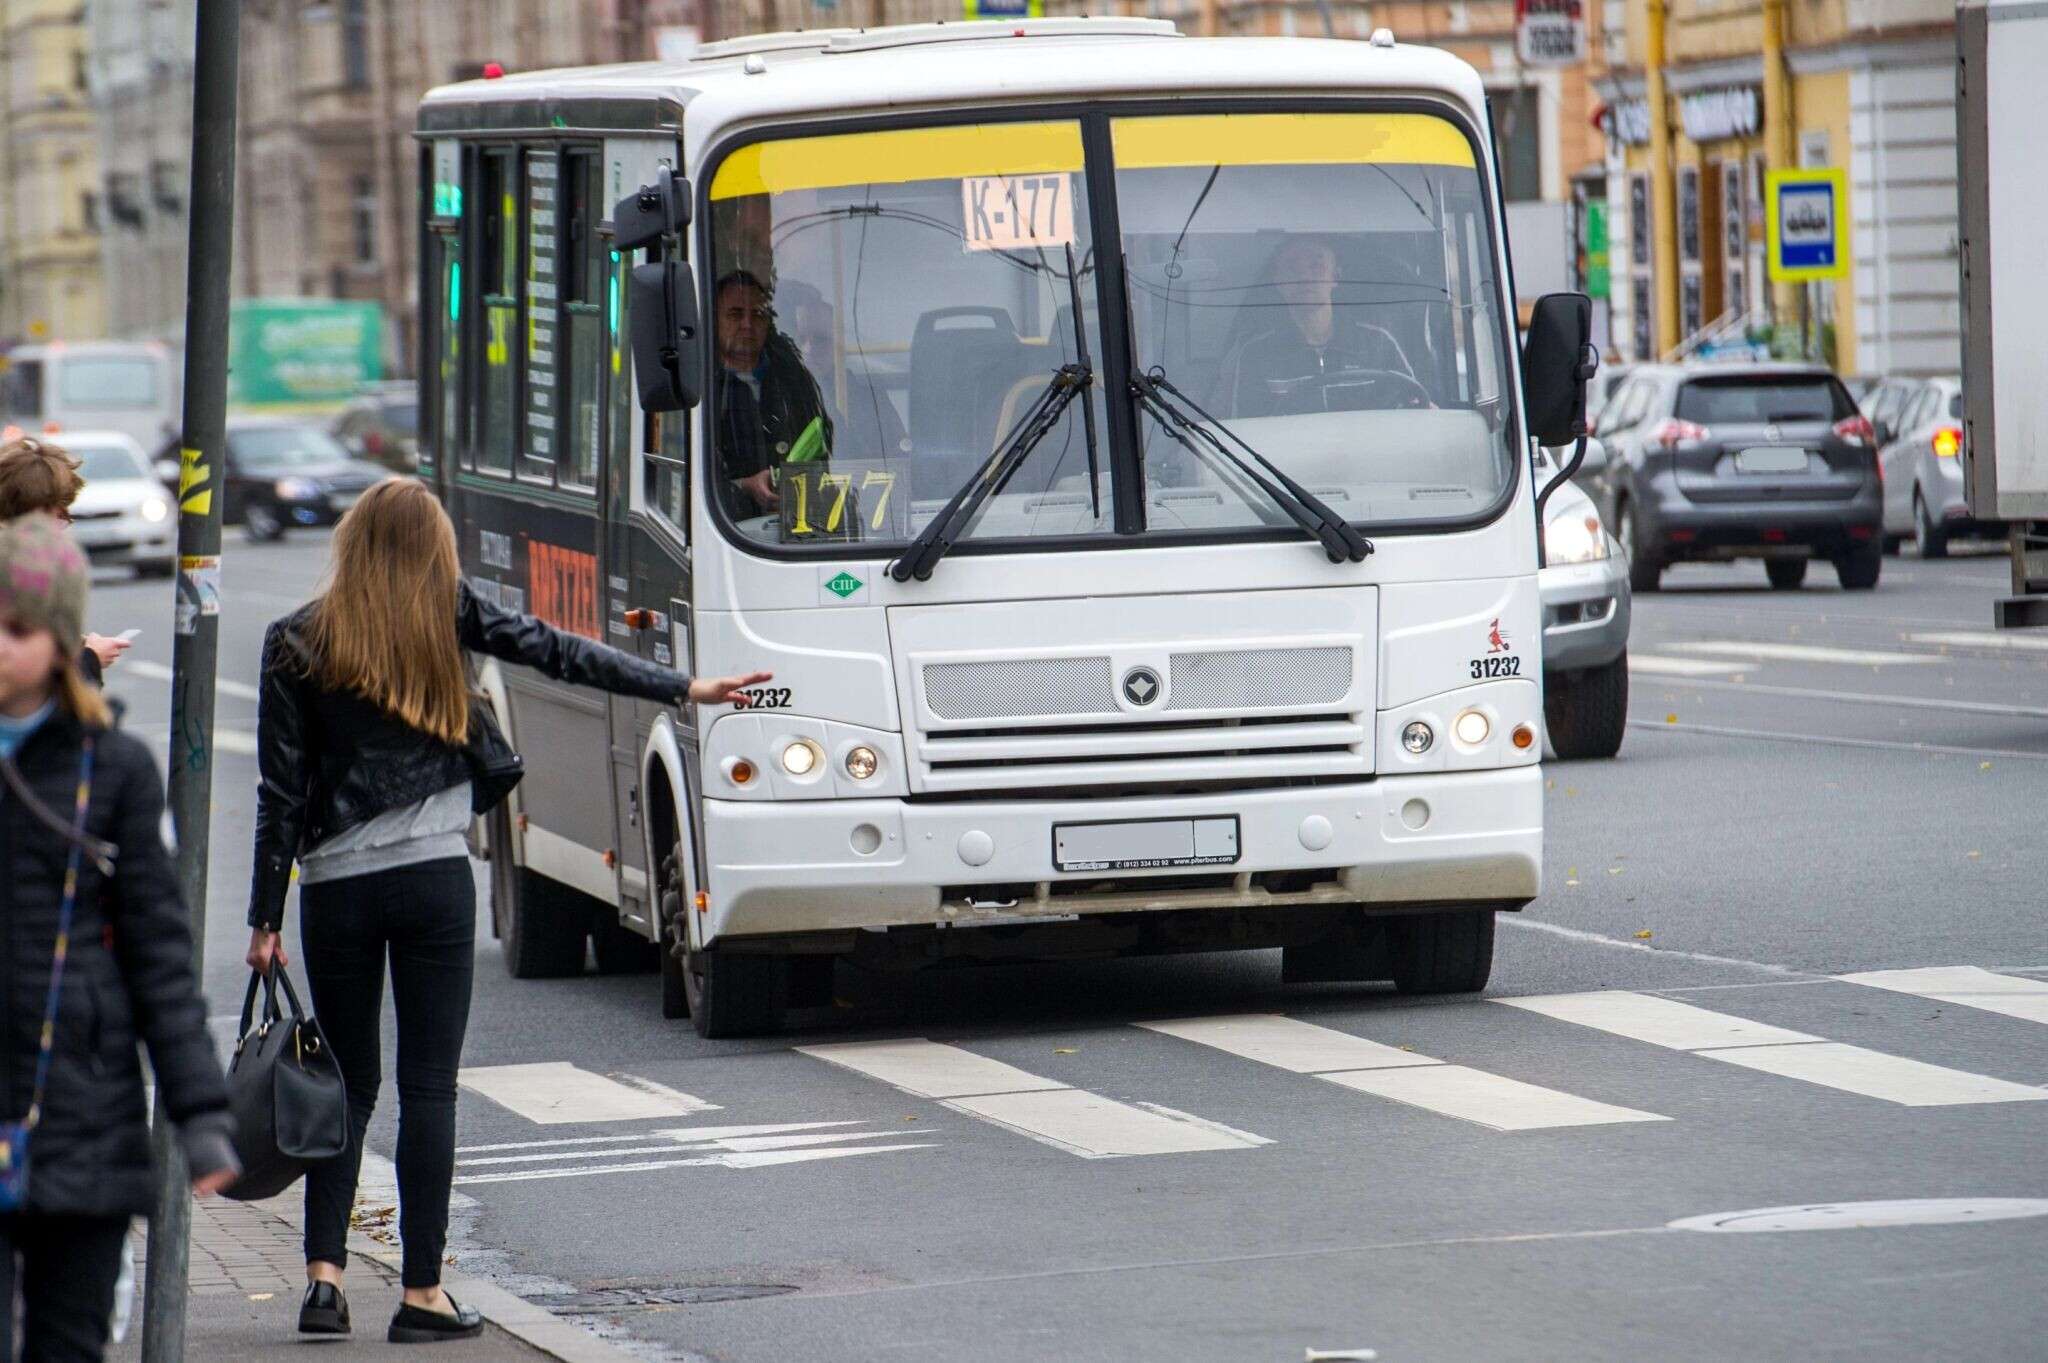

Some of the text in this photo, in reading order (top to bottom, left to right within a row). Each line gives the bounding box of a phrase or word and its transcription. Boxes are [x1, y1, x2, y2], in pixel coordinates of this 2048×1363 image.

[970, 177, 1060, 240] К-177
[790, 470, 896, 533] 177
[1470, 656, 1521, 679] 31232
[1123, 860, 1139, 869] (812)
[1173, 856, 1233, 865] www.piterbus.com
